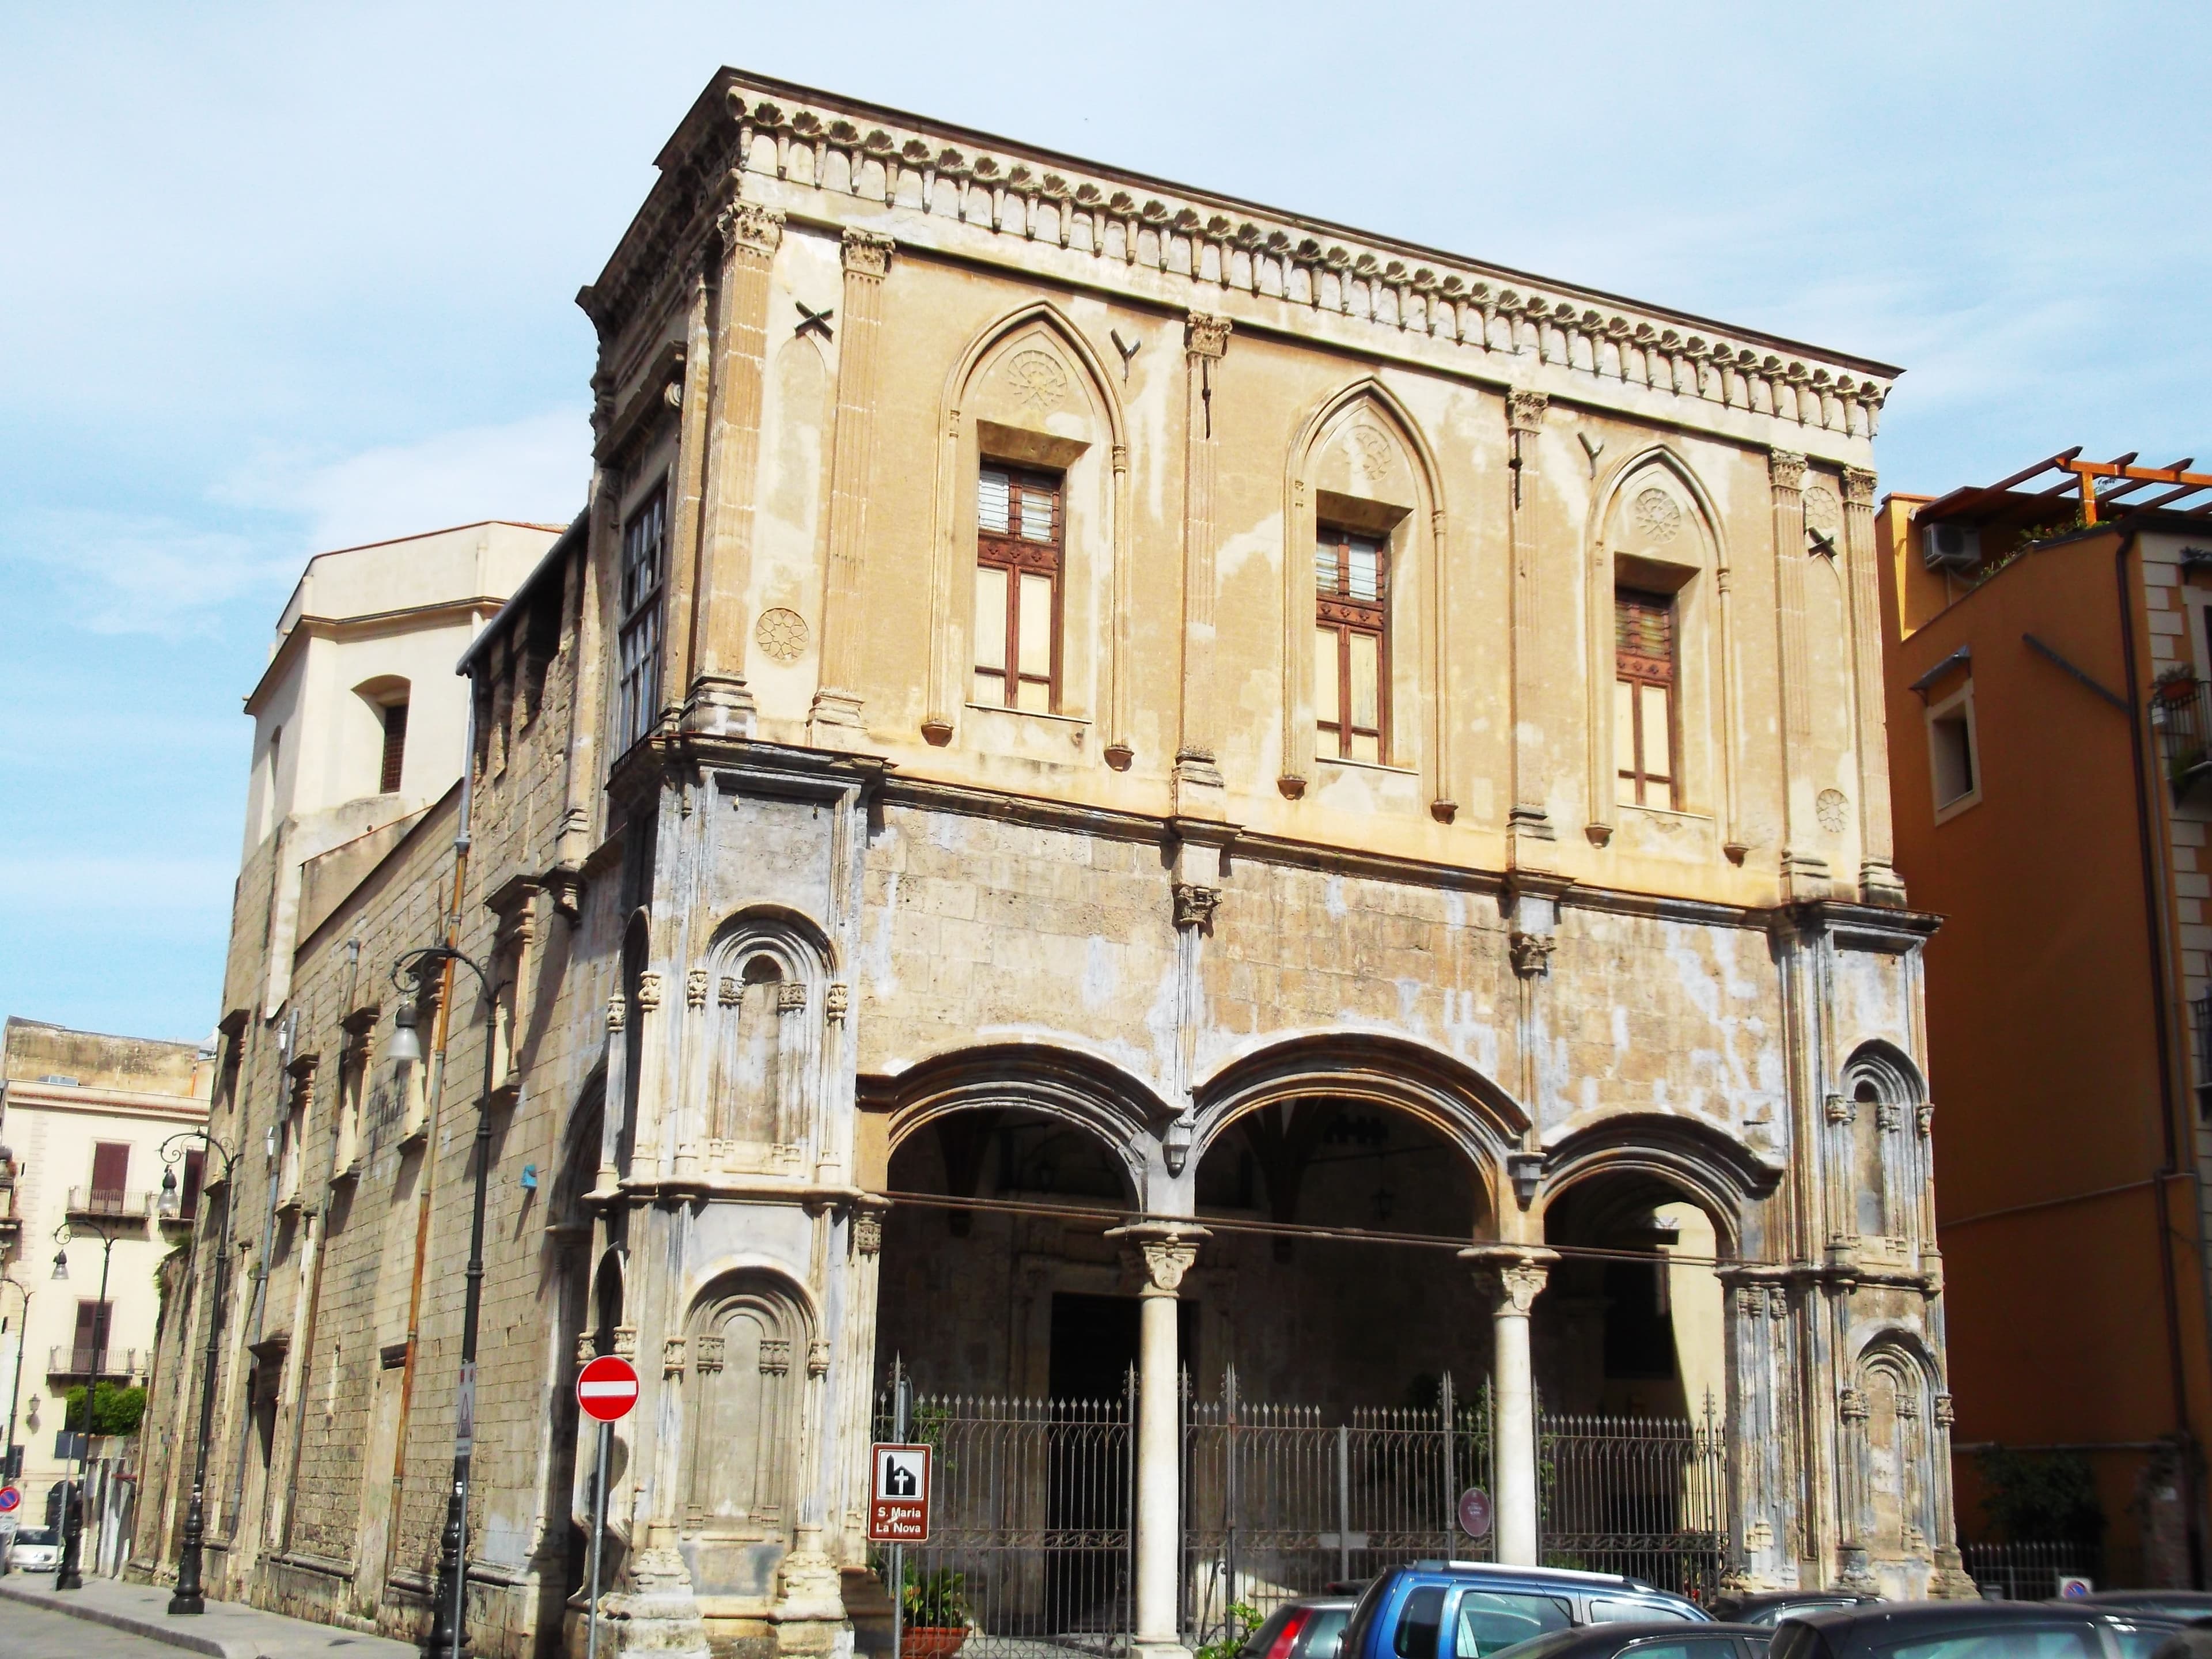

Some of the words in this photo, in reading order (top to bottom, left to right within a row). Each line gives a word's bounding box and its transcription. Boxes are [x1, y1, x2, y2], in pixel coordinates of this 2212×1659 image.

[878, 1507, 888, 1517] S.
[892, 1507, 921, 1517] Maria
[876, 1522, 889, 1533] La
[893, 1522, 921, 1533] Nova
